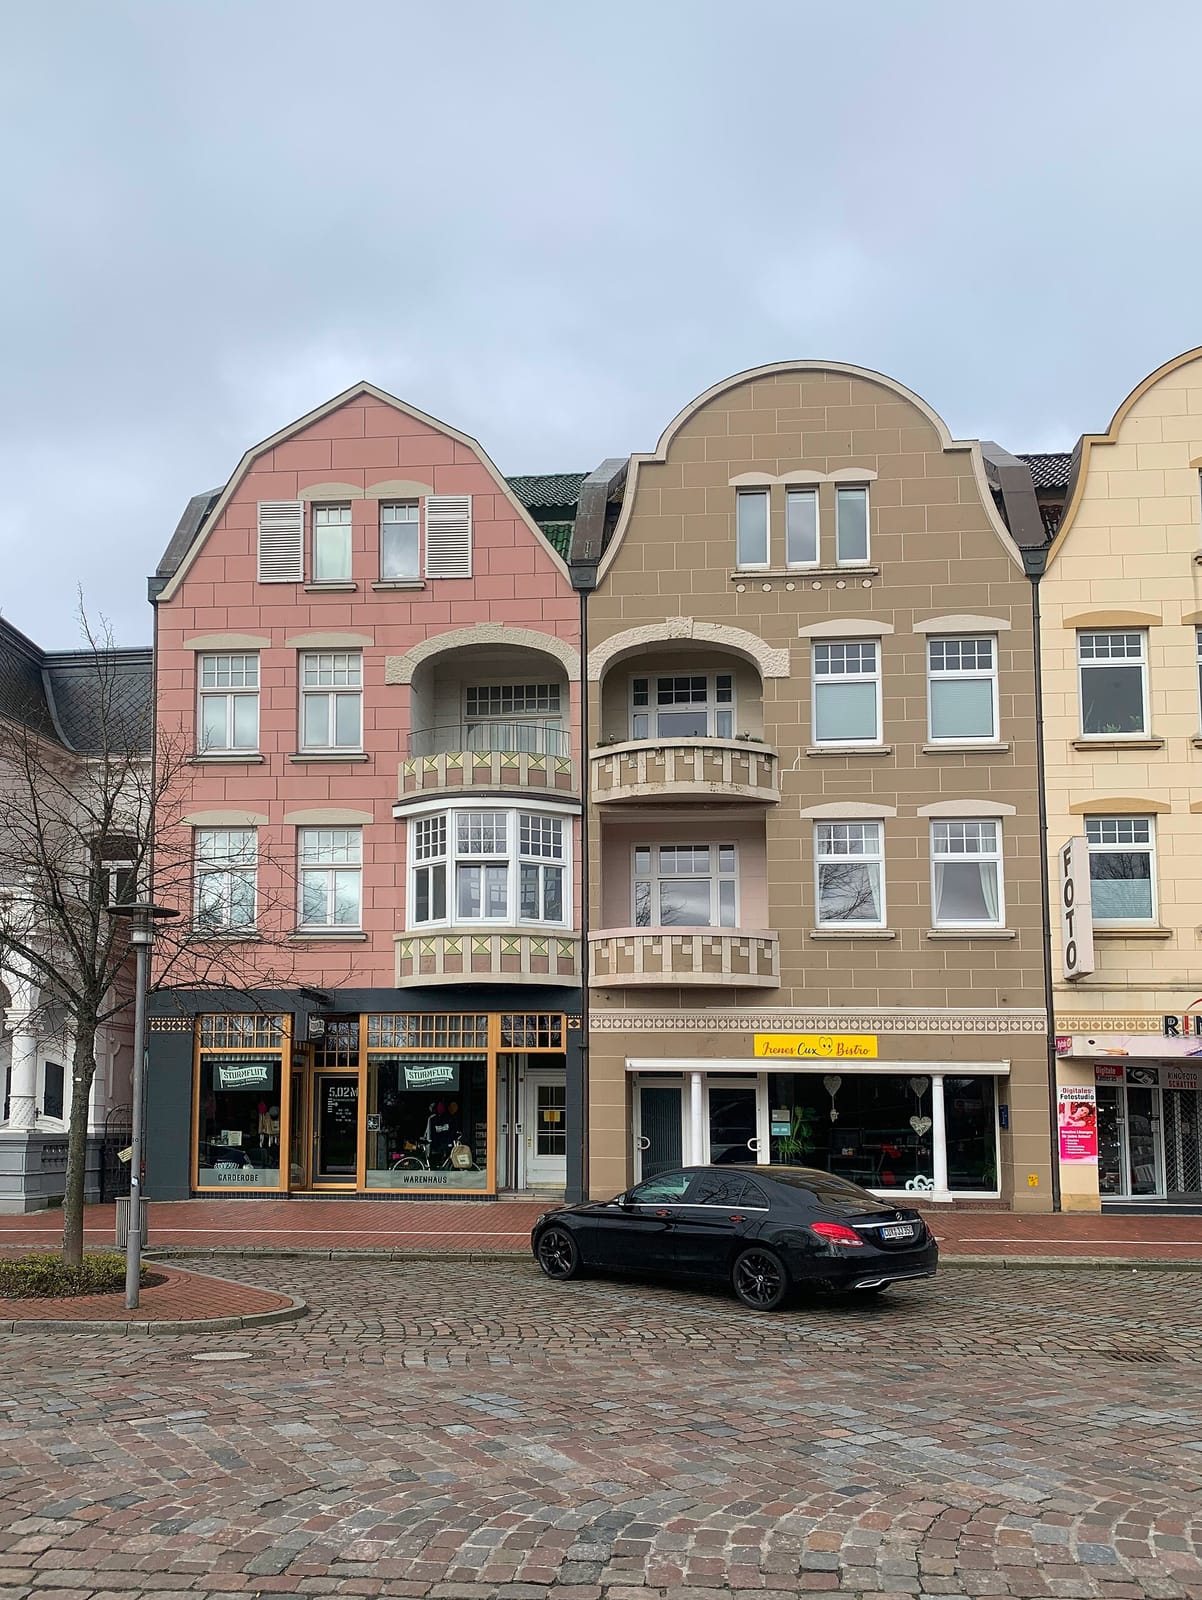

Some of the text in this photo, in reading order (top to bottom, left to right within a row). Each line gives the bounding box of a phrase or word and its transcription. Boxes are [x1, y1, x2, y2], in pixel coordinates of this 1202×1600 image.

[1063, 846, 1077, 970] FOTO
[797, 1042, 818, 1056] Cux
[836, 1042, 870, 1056] Bistro
[223, 1068, 263, 1079] STURMFLUT
[409, 1068, 450, 1080] STURMFLUT
[217, 1174, 259, 1182] GARDEROBE
[403, 1175, 448, 1184] WARENHAUS
